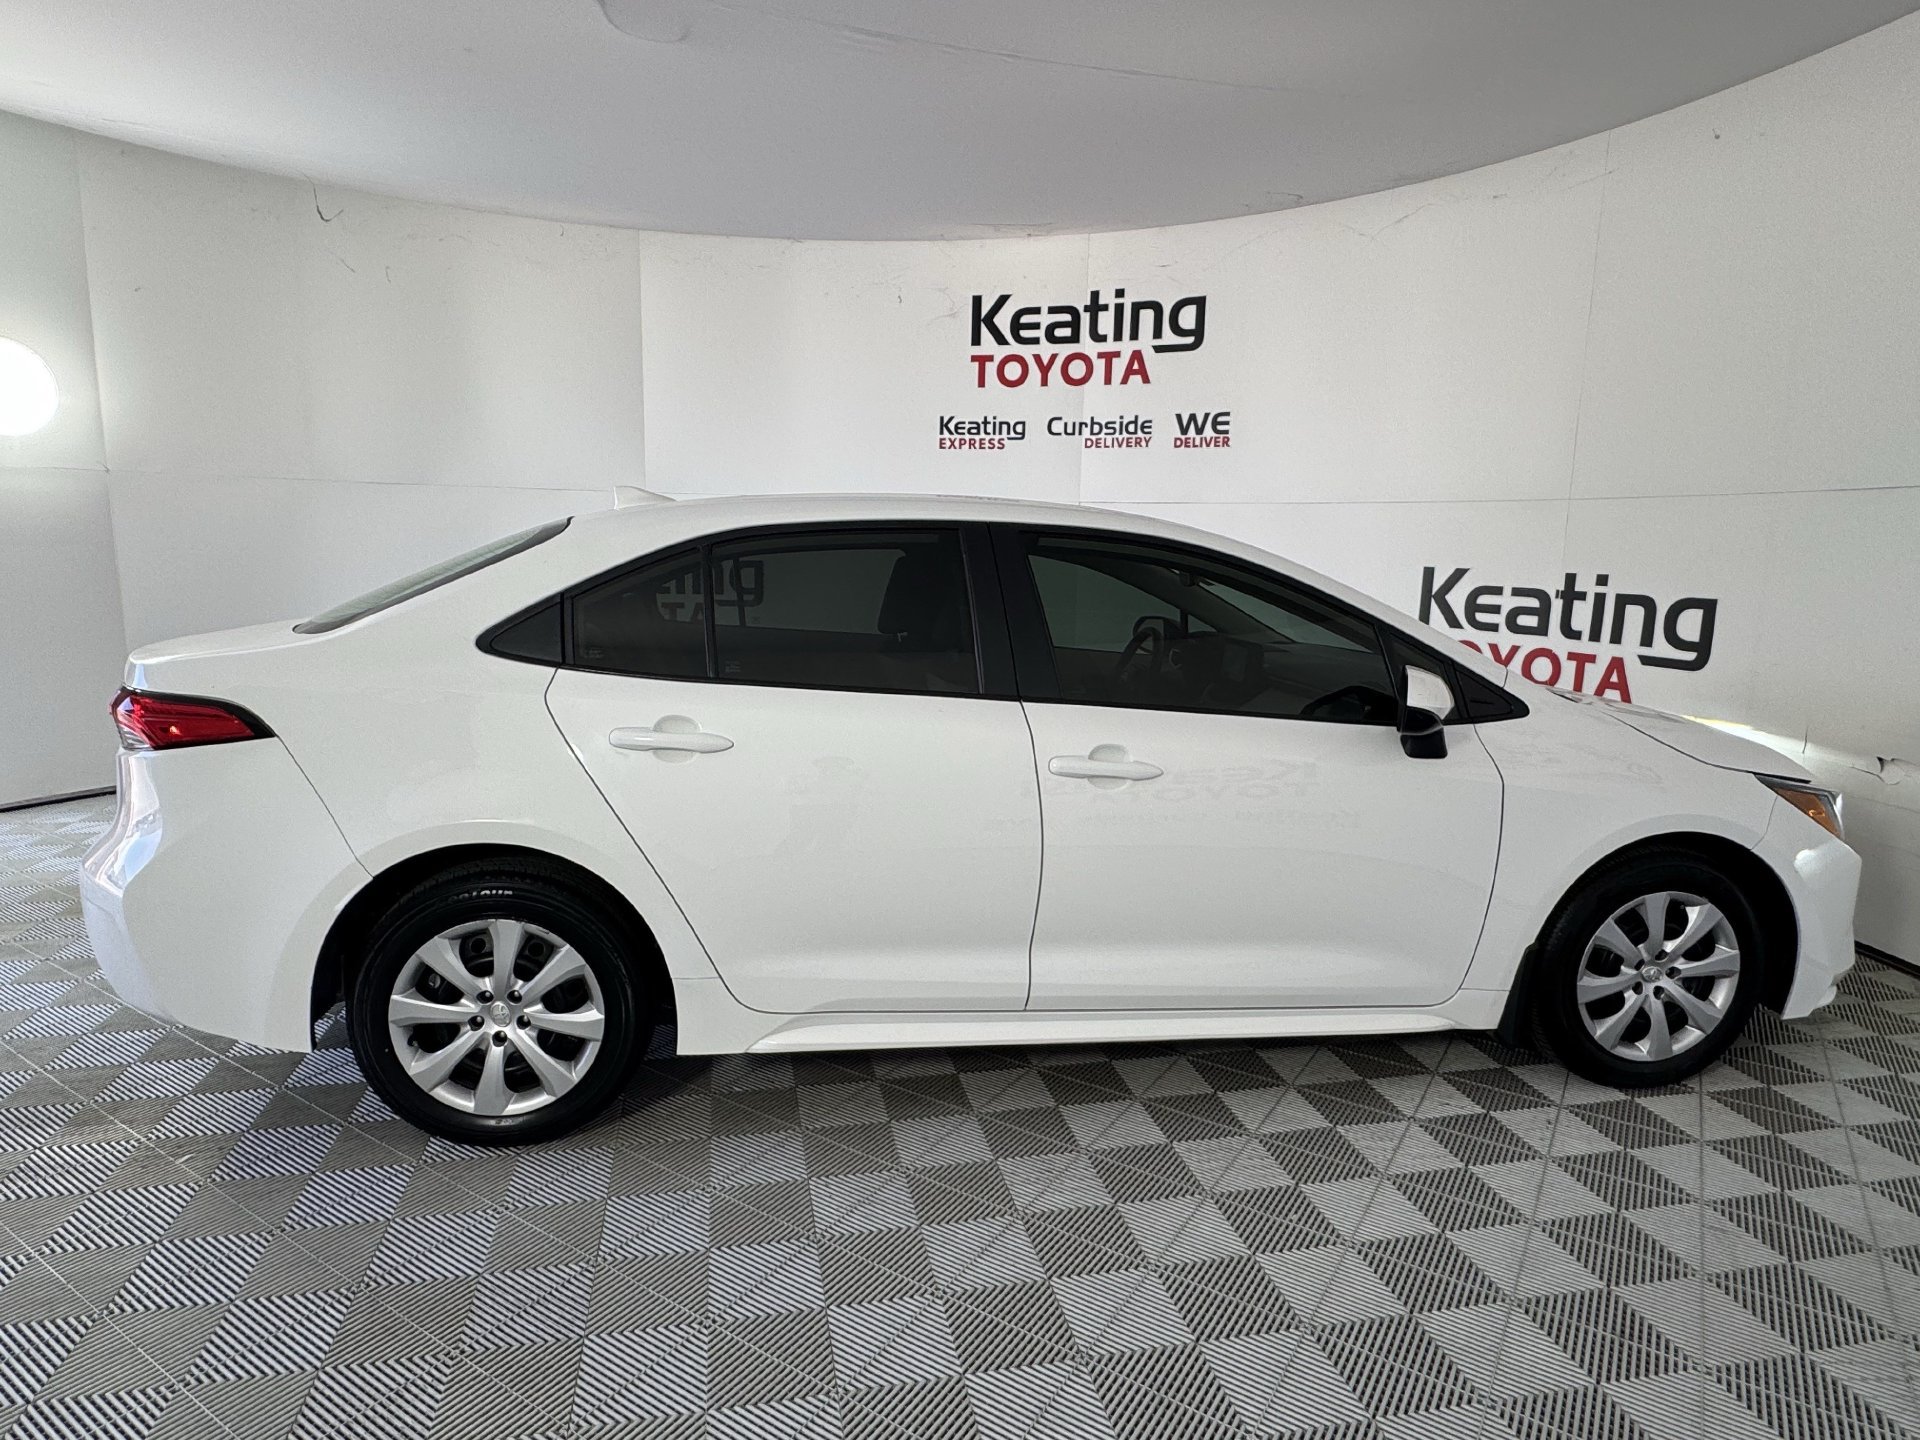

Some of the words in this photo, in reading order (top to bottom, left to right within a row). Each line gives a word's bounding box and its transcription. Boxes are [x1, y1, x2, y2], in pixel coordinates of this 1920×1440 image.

[970, 287, 1207, 354] Keating
[970, 349, 1151, 388] TOYOTA
[939, 415, 1026, 440] Keating
[1047, 414, 1153, 436] Curbside
[1175, 411, 1231, 436] WE
[938, 437, 1006, 450] EXPRESS
[1084, 436, 1153, 449] DELIVERY
[1173, 436, 1231, 448] DELIVER
[1418, 566, 1719, 672] Keating
[1456, 639, 1633, 704] YOTA
